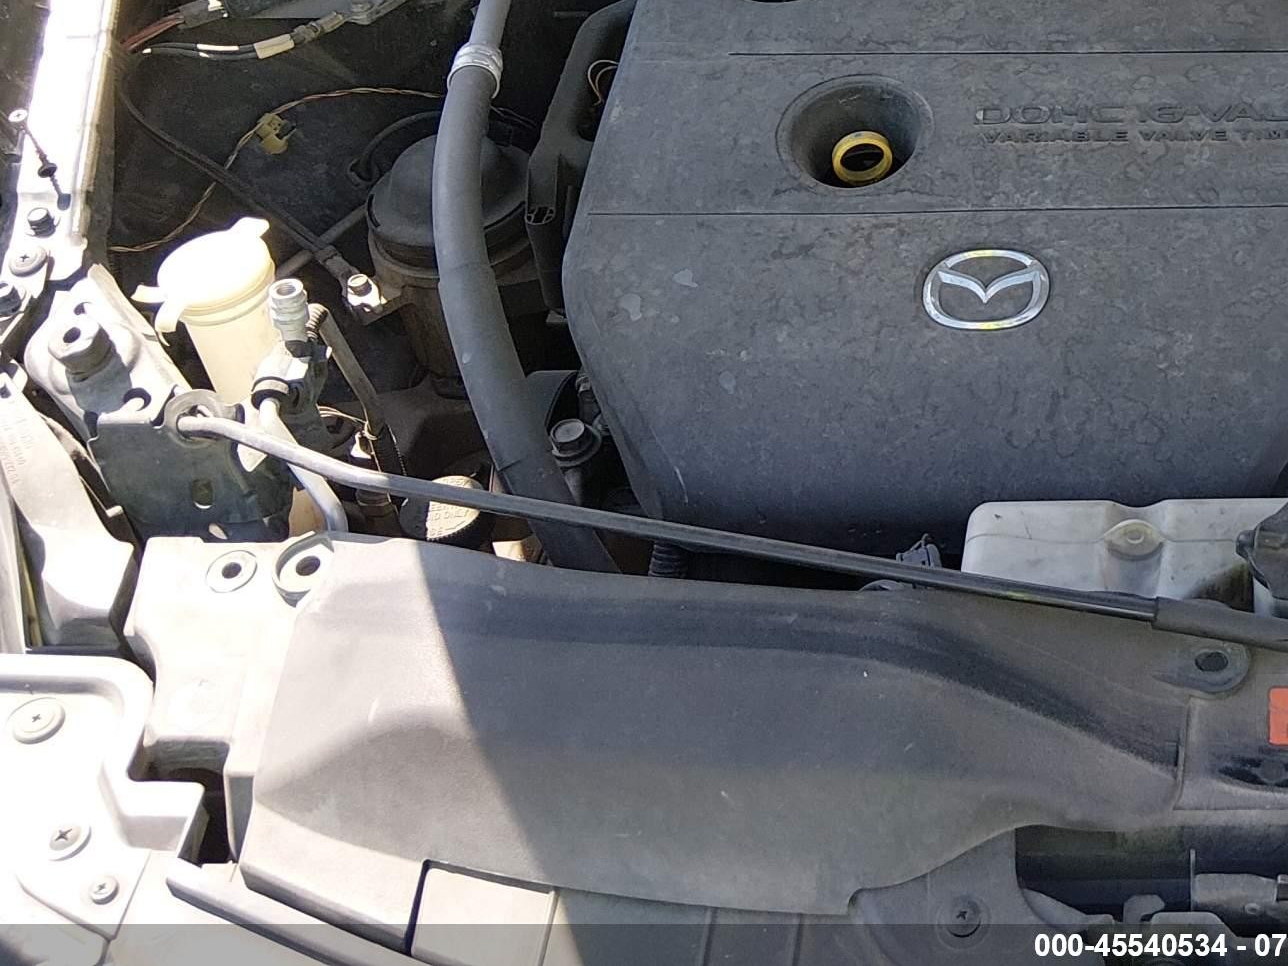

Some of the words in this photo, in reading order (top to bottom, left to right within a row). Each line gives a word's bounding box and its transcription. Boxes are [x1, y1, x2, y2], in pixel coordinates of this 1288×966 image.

[974, 103, 1129, 125] DOHC
[982, 129, 1129, 144] VARIABLE
[1139, 129, 1228, 142] VALVE
